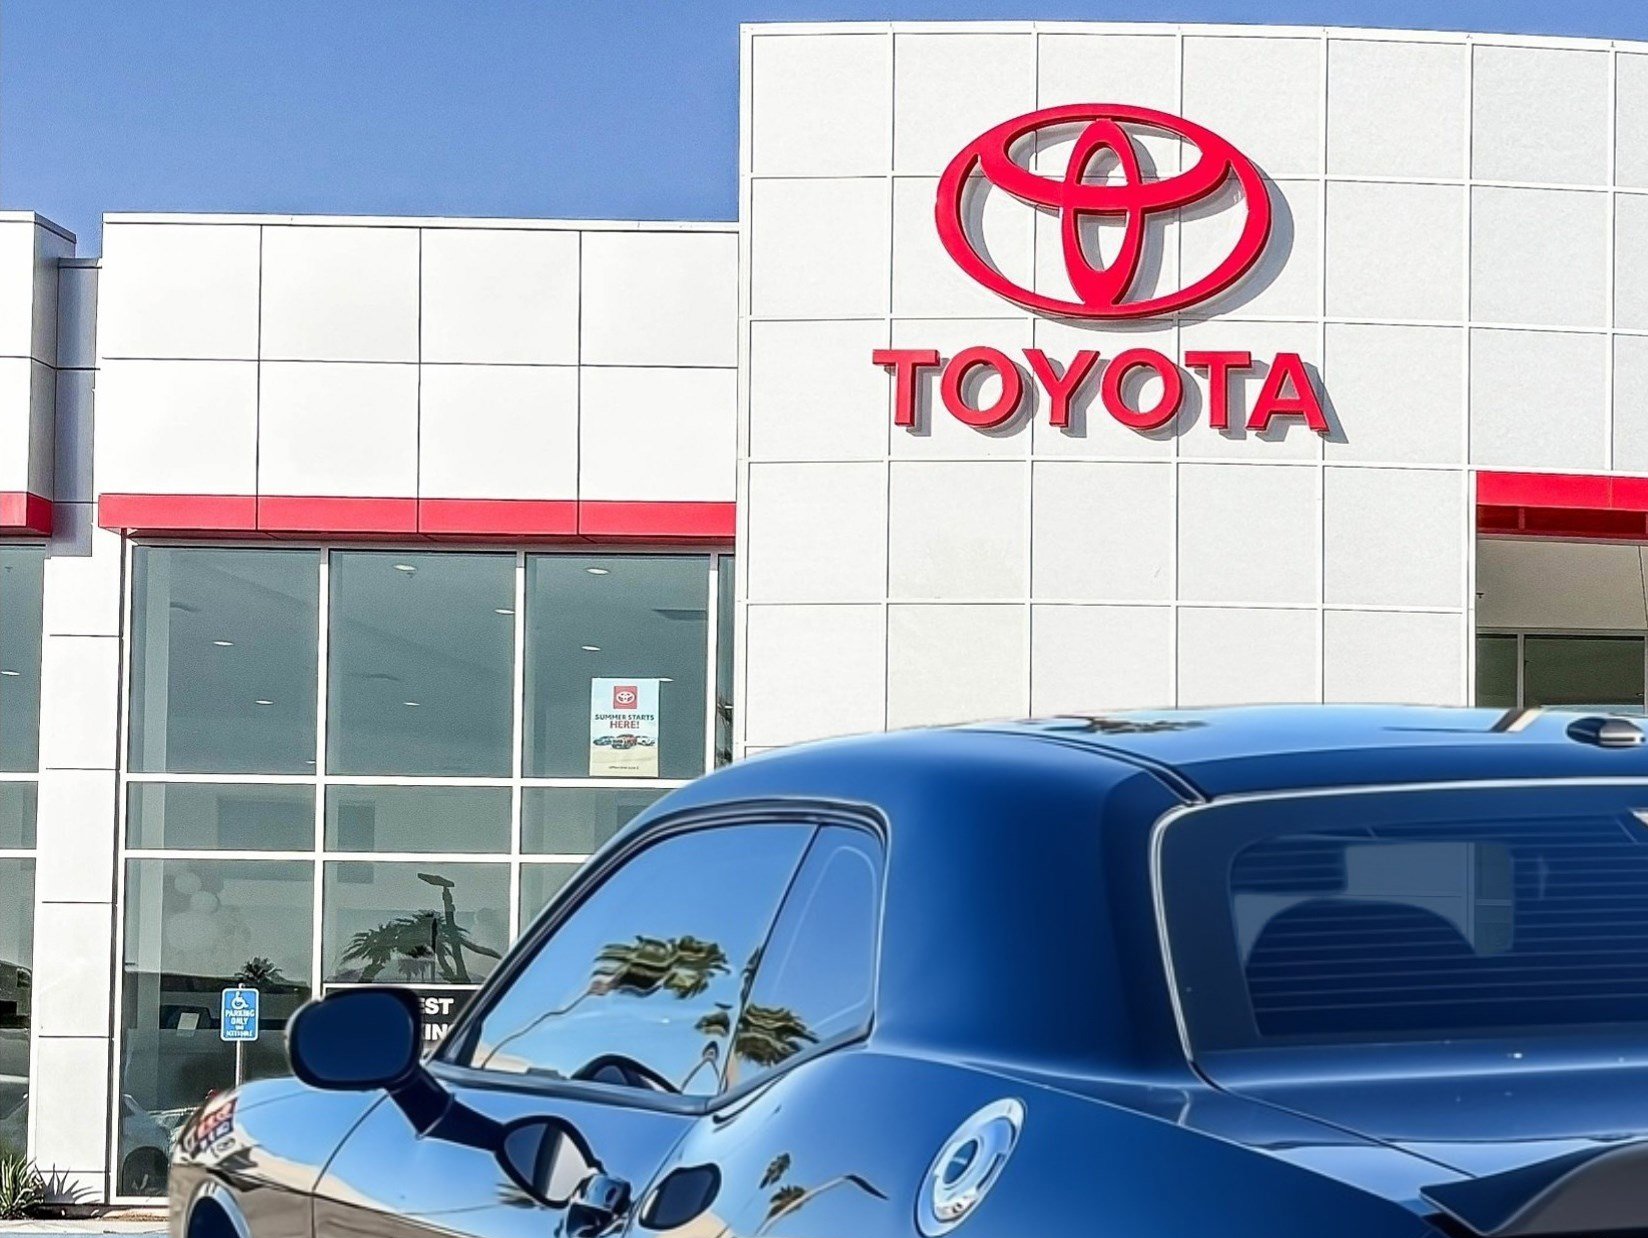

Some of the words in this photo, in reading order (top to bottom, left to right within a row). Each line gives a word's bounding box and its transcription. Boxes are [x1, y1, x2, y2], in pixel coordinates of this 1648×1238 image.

[872, 346, 1330, 432] TOYOTA
[609, 720, 640, 729] HERE!
[225, 1009, 255, 1018] PARKING
